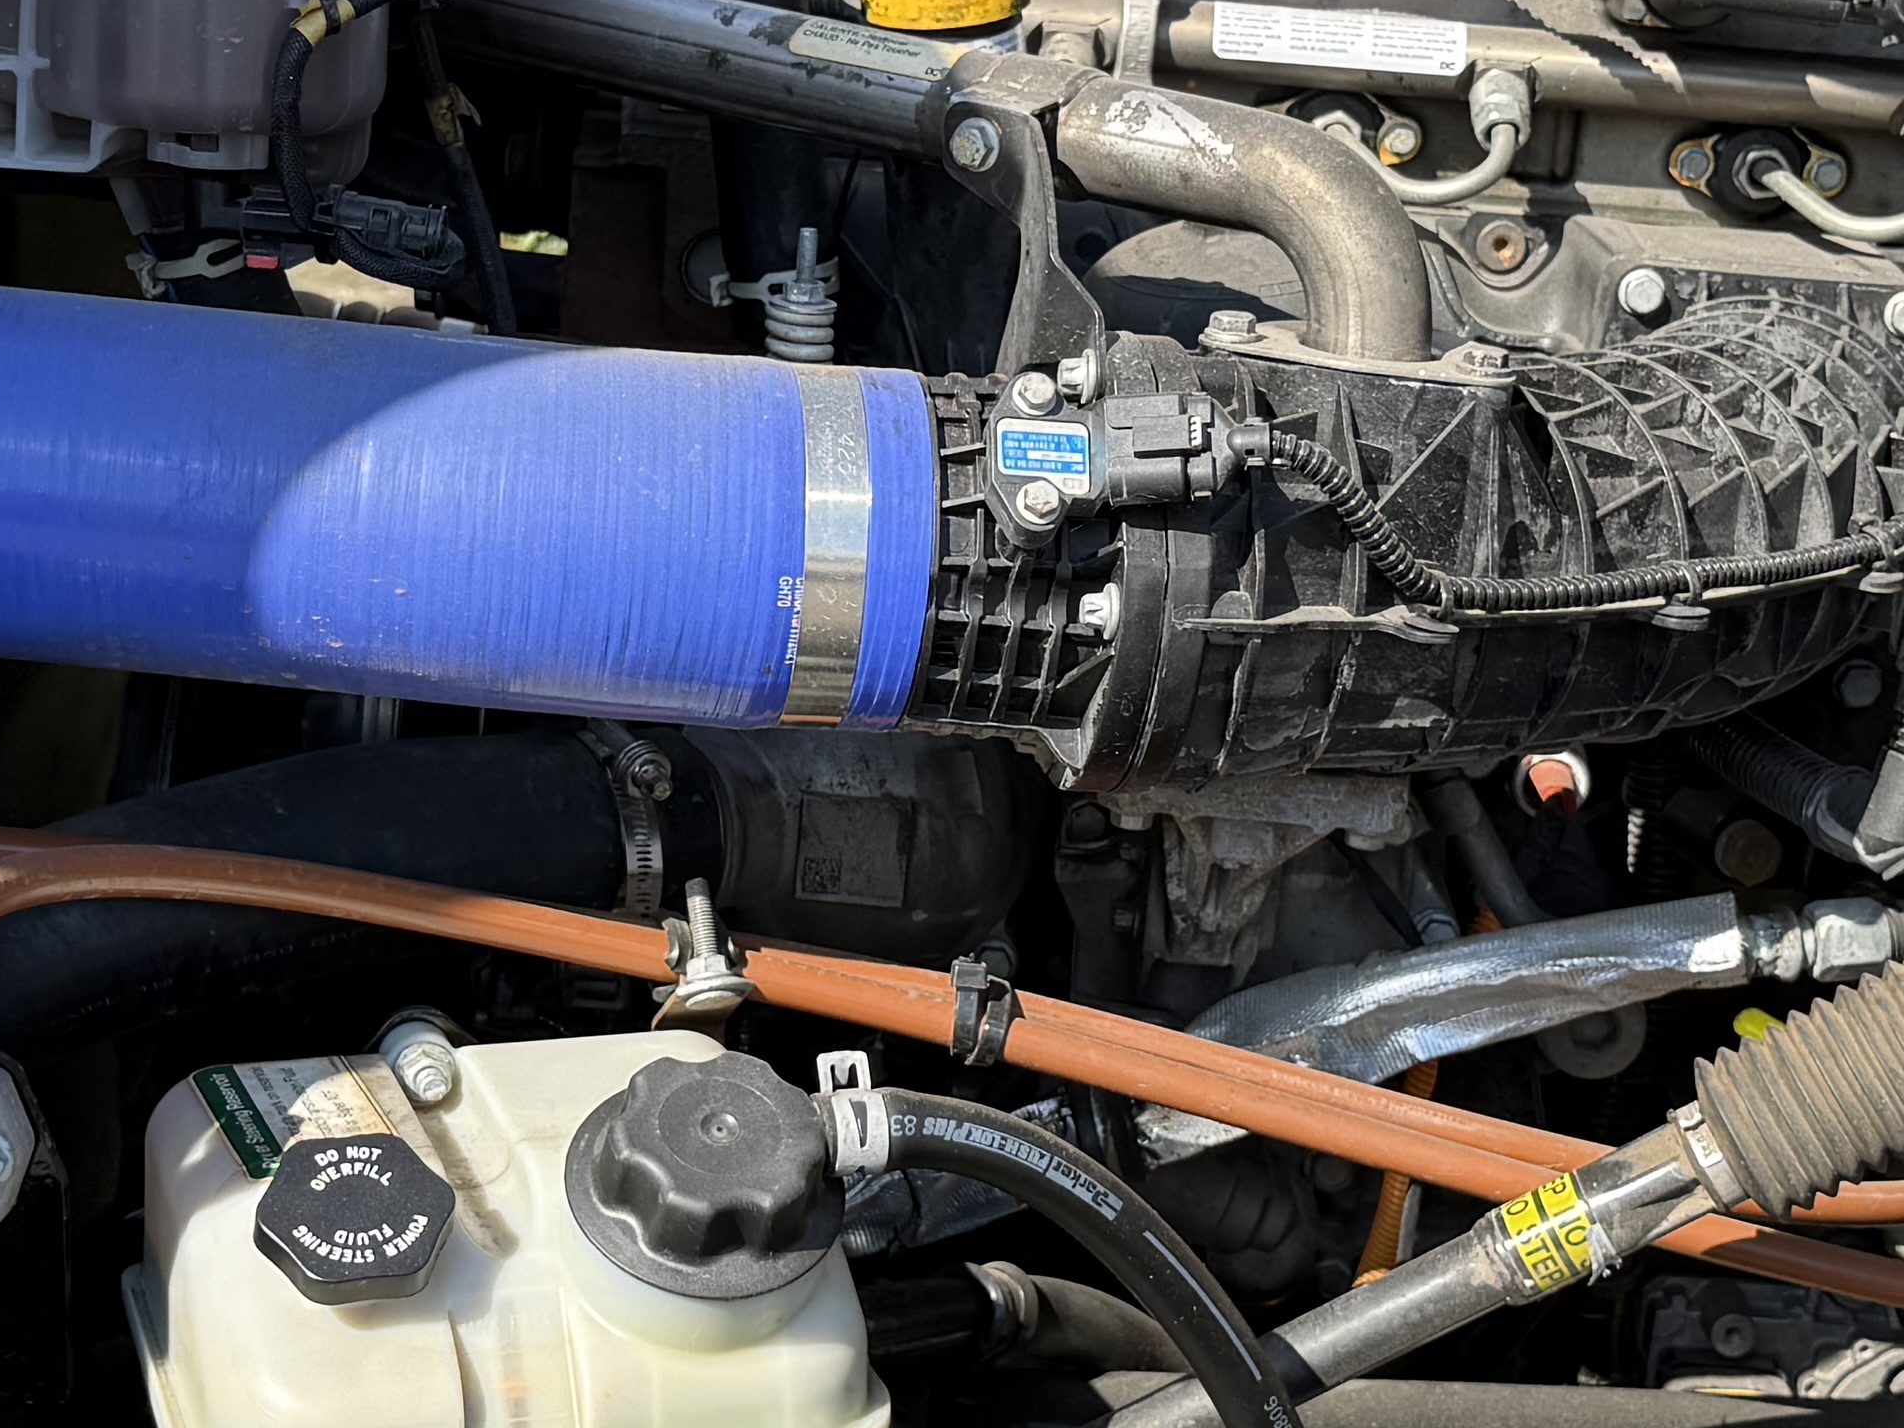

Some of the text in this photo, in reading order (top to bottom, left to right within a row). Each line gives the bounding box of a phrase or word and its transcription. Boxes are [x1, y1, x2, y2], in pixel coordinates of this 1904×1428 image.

[777, 576, 793, 608] GH70
[207, 1073, 245, 1113] Reservoir
[234, 1105, 265, 1146] Steering
[315, 1146, 382, 1167] DO NOT
[310, 1162, 393, 1191] OVERFILL
[1051, 1158, 1118, 1214] Parker
[292, 1214, 429, 1263] POWER STEERING
[334, 1223, 394, 1247] FLUID
